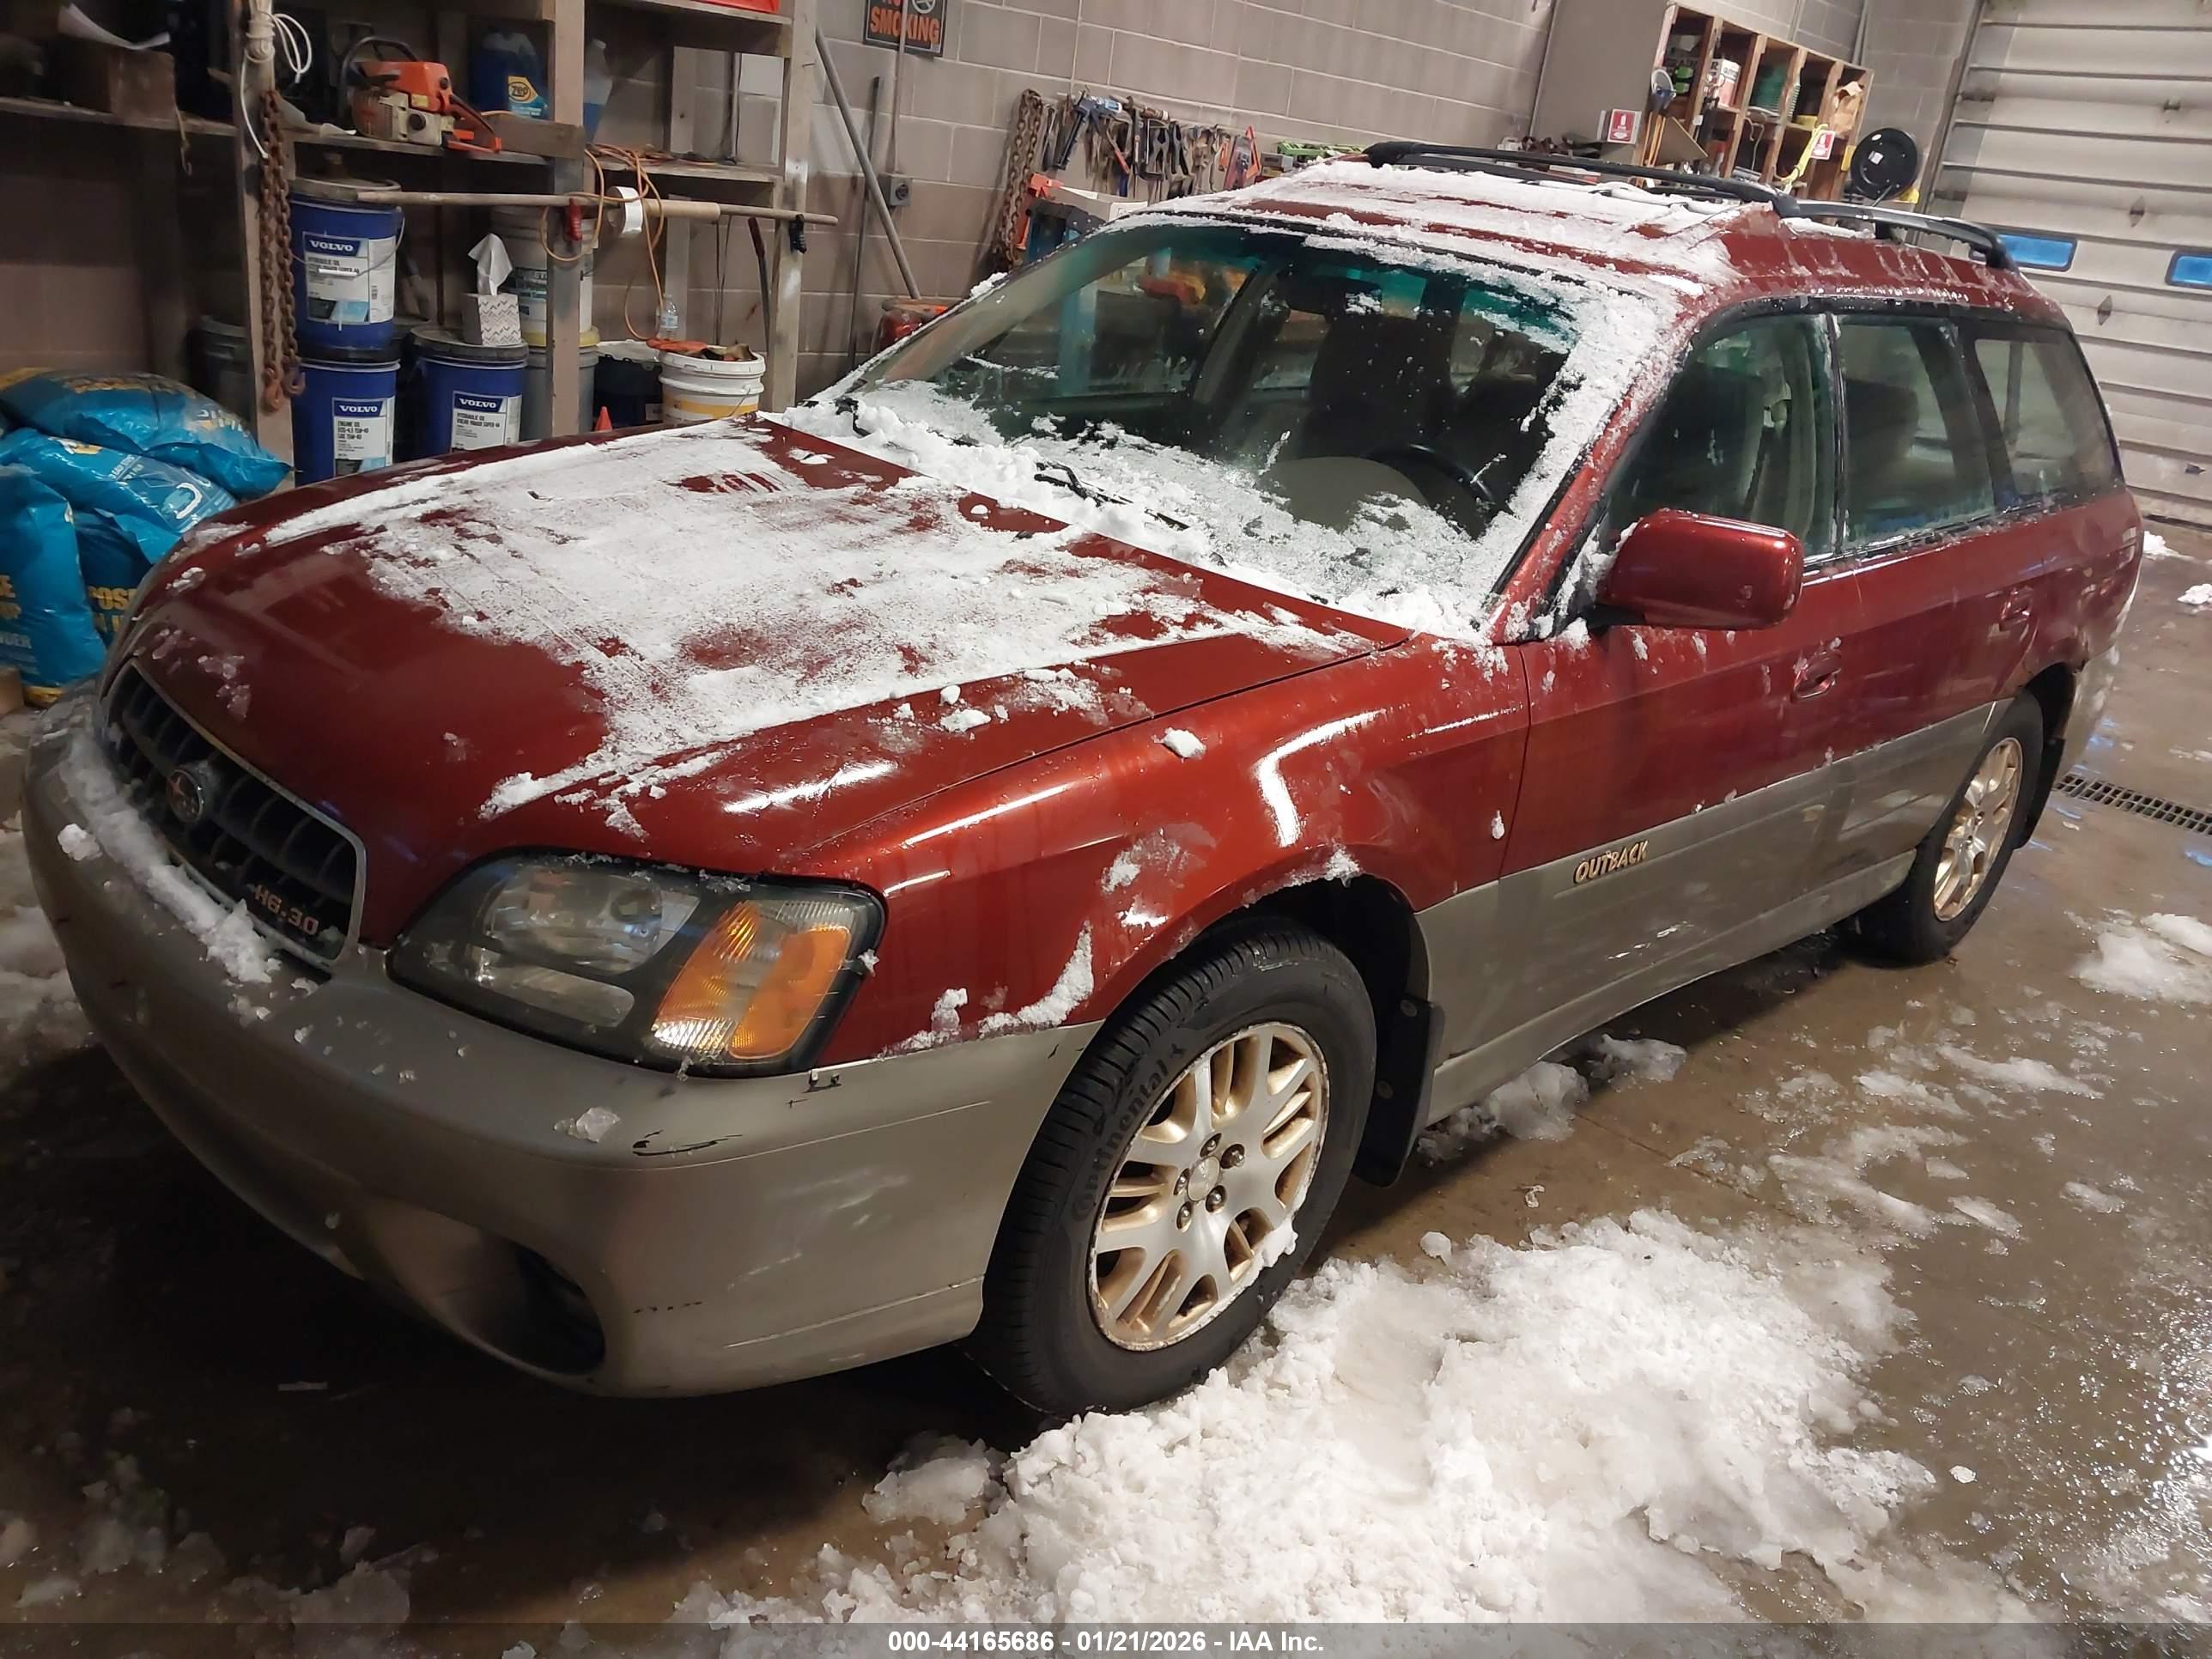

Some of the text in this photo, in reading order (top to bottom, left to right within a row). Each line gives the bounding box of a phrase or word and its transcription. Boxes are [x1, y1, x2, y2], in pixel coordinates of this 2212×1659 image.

[309, 240, 354, 252] VOLVO
[338, 404, 379, 413] VOLVO
[459, 398, 497, 409] VOLVO
[1574, 840, 1649, 884] OUTBACK
